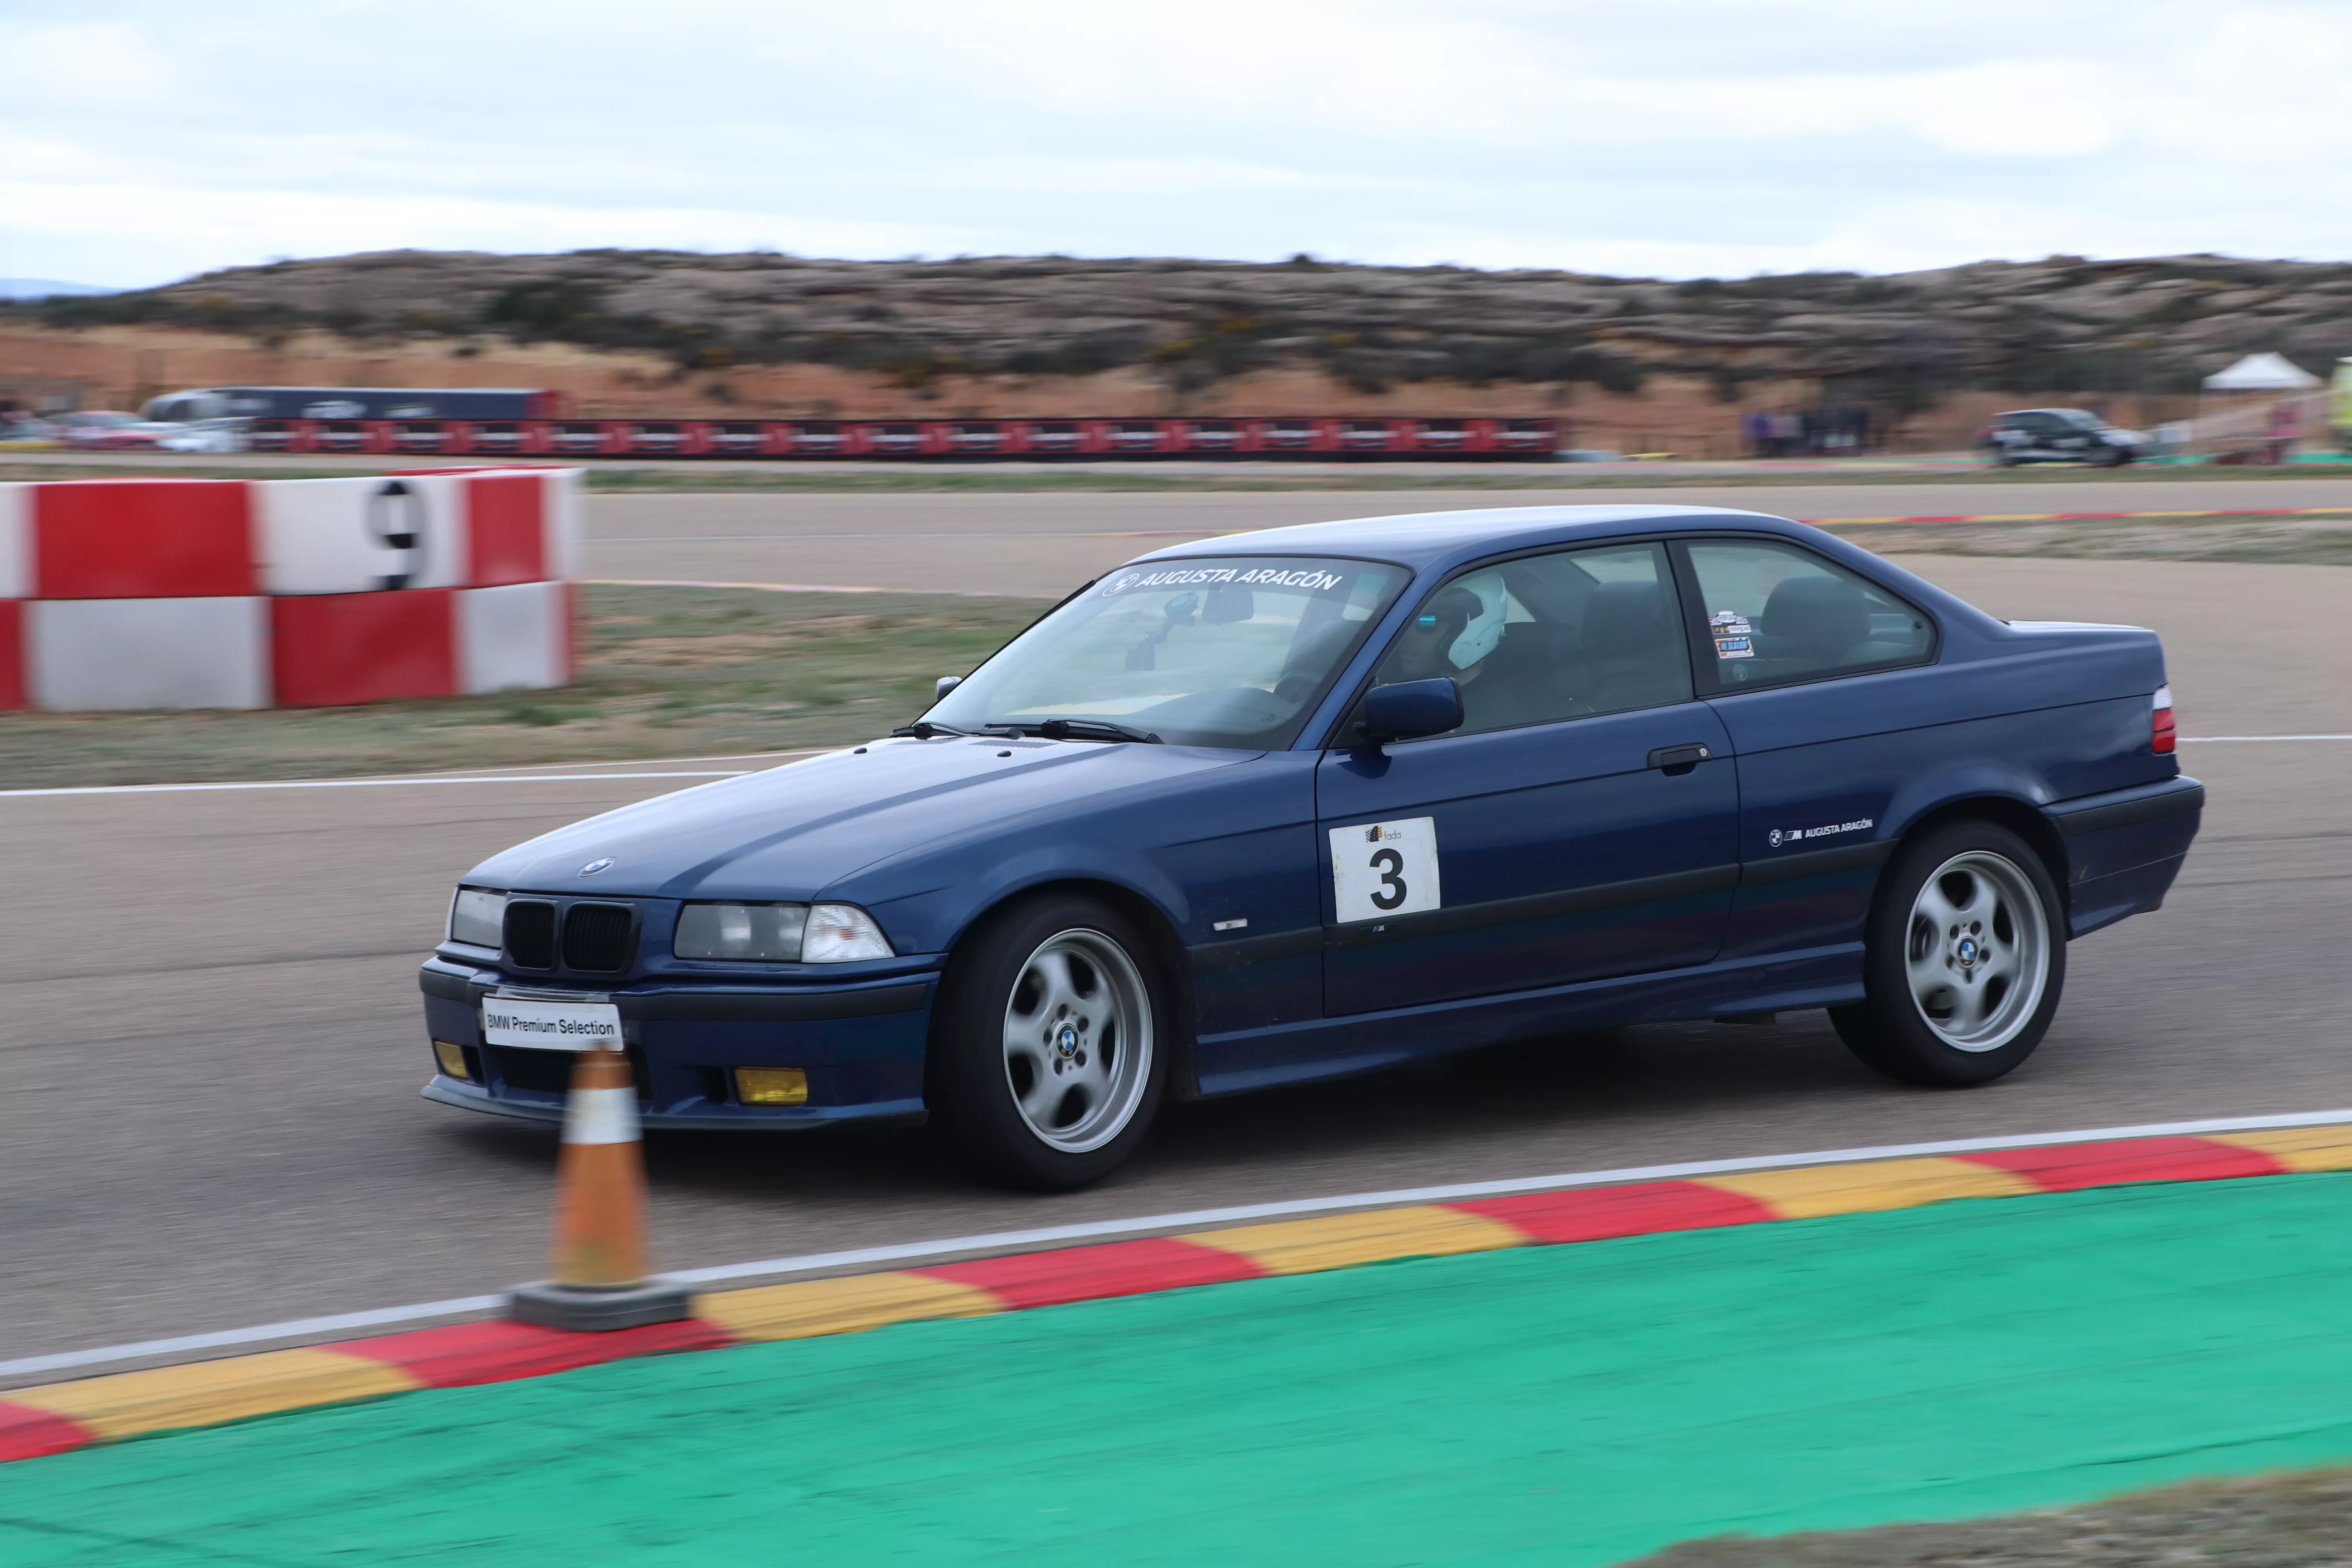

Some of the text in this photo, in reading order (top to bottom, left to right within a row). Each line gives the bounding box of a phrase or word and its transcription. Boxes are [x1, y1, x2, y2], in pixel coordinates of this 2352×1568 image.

[365, 479, 425, 590] 9
[1134, 569, 1343, 590] AUGUSTA ARAGÓN
[1384, 830, 1401, 840] fada
[1805, 824, 1840, 838] AUGUSTA
[1841, 818, 1873, 832] ARAGÓN
[1369, 848, 1407, 910] 3
[487, 1014, 615, 1035] BMW Premium Selection
